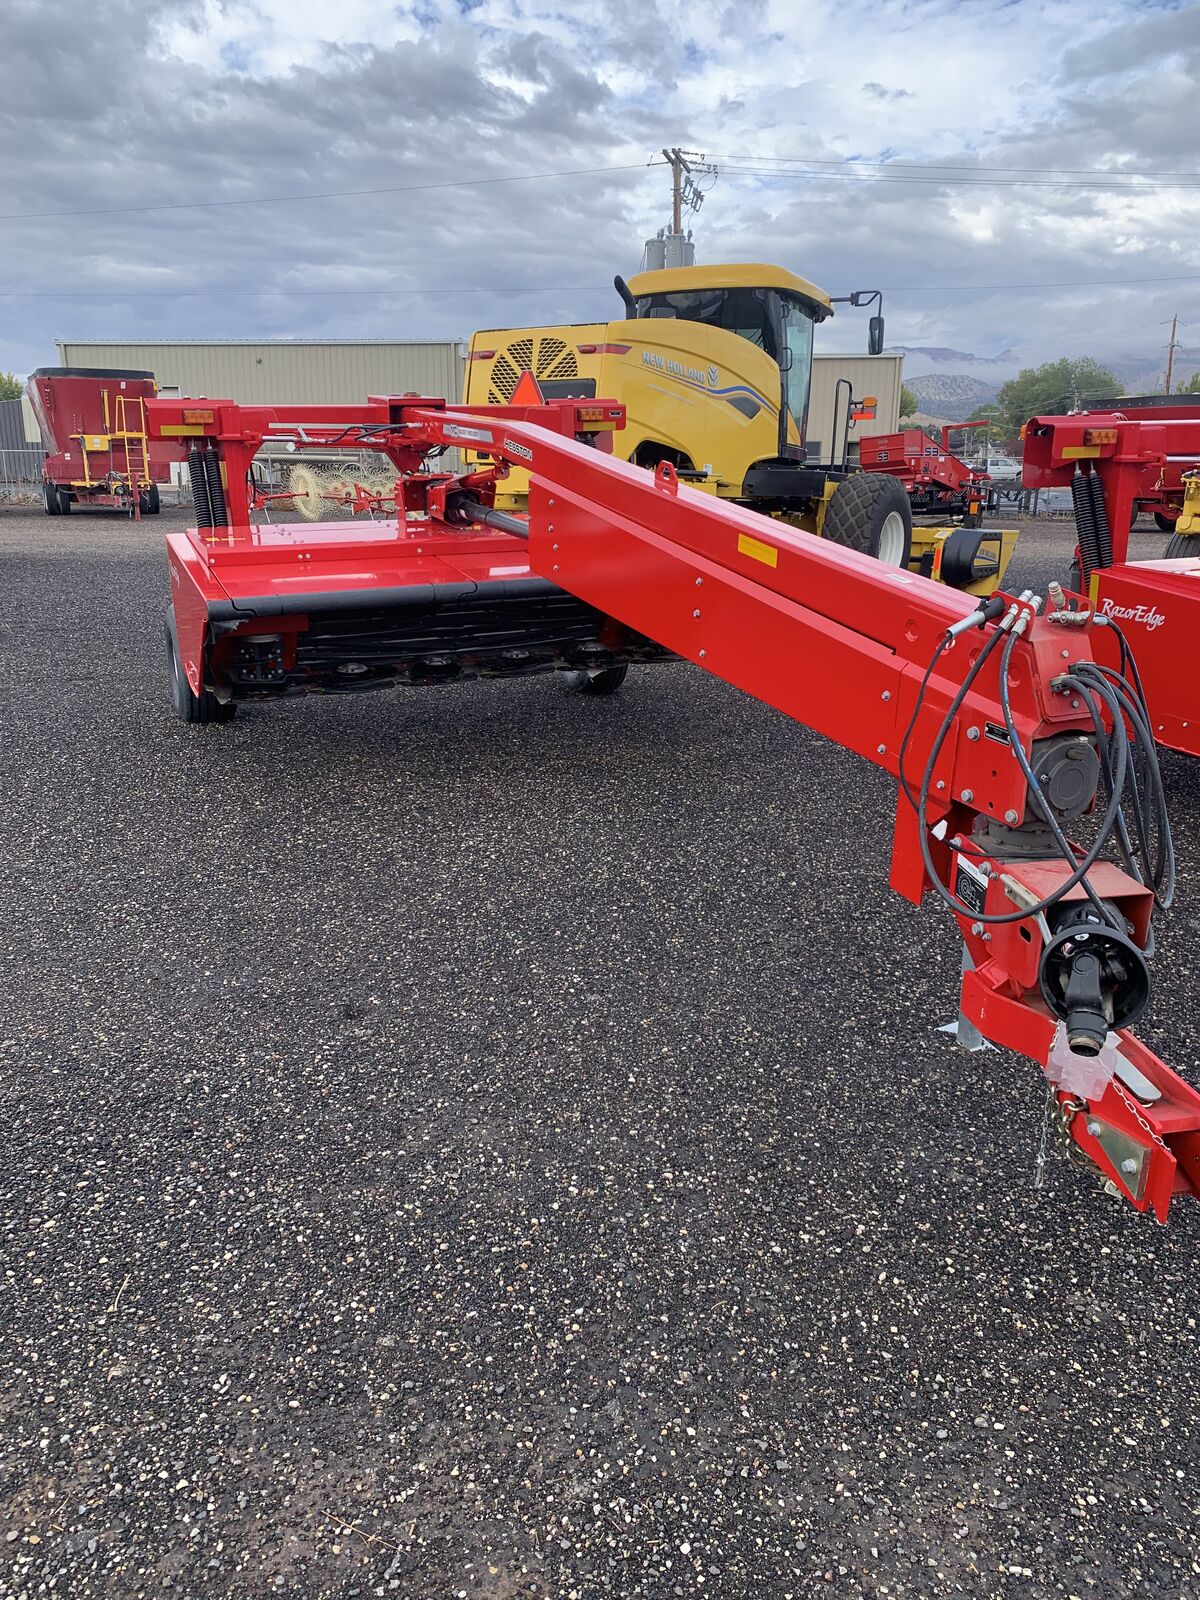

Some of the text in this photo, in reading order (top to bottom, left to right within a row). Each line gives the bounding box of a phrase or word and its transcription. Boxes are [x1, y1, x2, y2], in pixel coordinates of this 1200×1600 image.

[642, 351, 705, 384] NEW HOLLAND
[504, 438, 533, 461] HESSTON
[877, 451, 889, 462] S3
[923, 447, 939, 457] S3
[1102, 598, 1166, 631] RazorEdge
